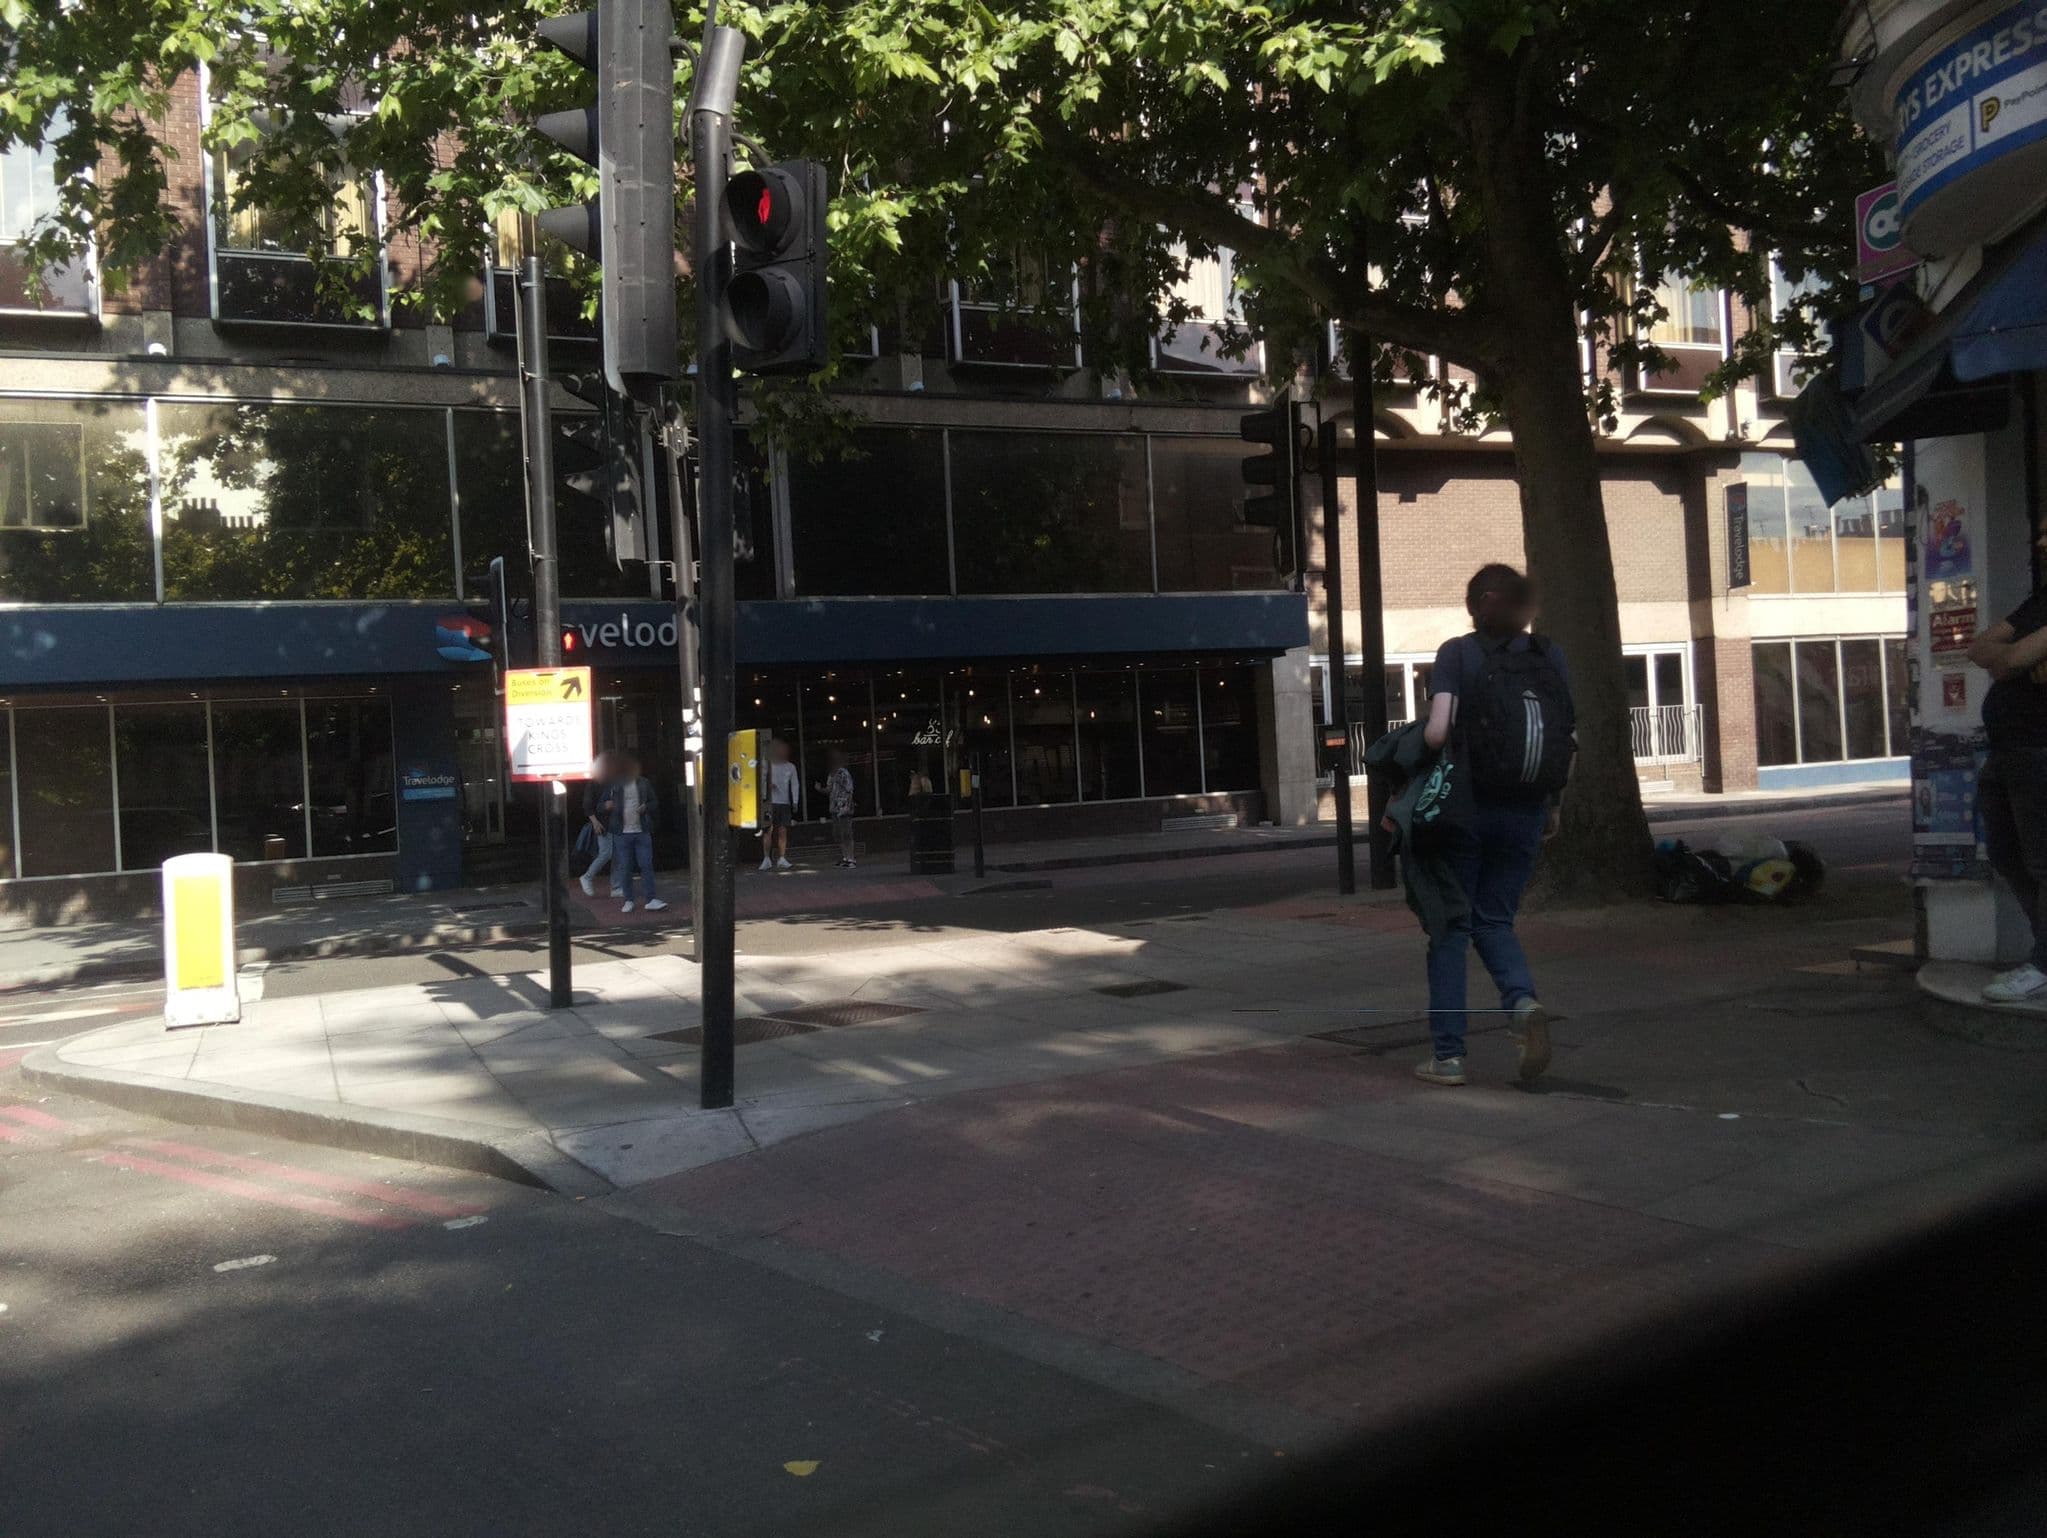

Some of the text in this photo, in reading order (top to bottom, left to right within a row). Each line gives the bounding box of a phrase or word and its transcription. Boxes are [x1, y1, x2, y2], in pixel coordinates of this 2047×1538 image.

[1925, 8, 2047, 108] EXPRESS
[1733, 512, 1745, 580] Travelodge
[511, 678, 550, 687] Buses on
[511, 689, 552, 698] Diversion
[527, 729, 567, 741] KINGS
[912, 731, 933, 745] bar
[527, 743, 569, 755] CROSS
[402, 775, 455, 786] Travelodge
